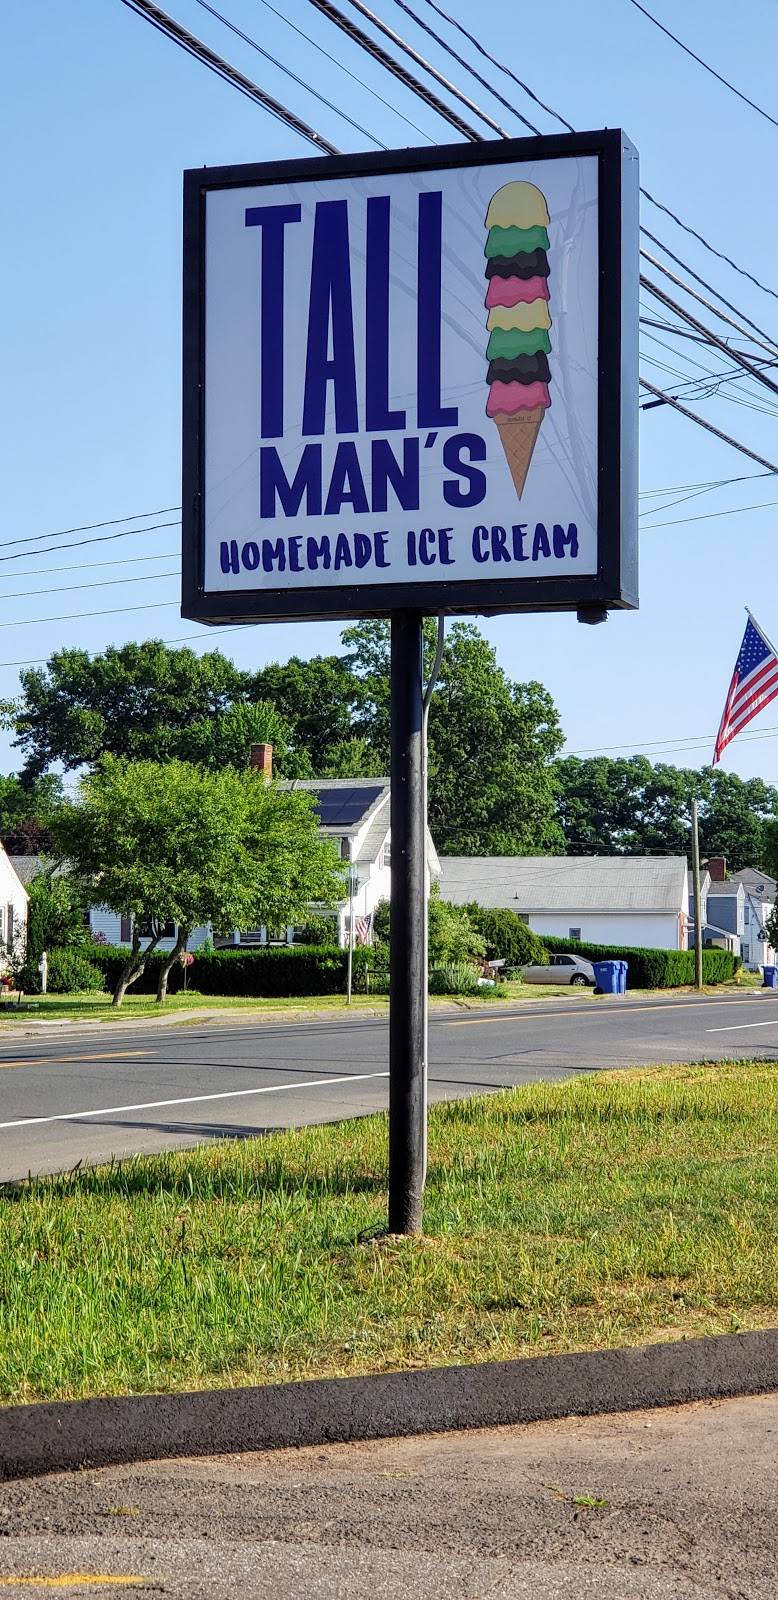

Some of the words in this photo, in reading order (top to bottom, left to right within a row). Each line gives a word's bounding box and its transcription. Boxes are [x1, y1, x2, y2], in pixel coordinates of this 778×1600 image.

[245, 191, 458, 438] TALL
[260, 432, 487, 519] MAN'S
[220, 531, 392, 574] HOMEMADE
[407, 527, 454, 566] ICE
[472, 523, 579, 562] CREAM
